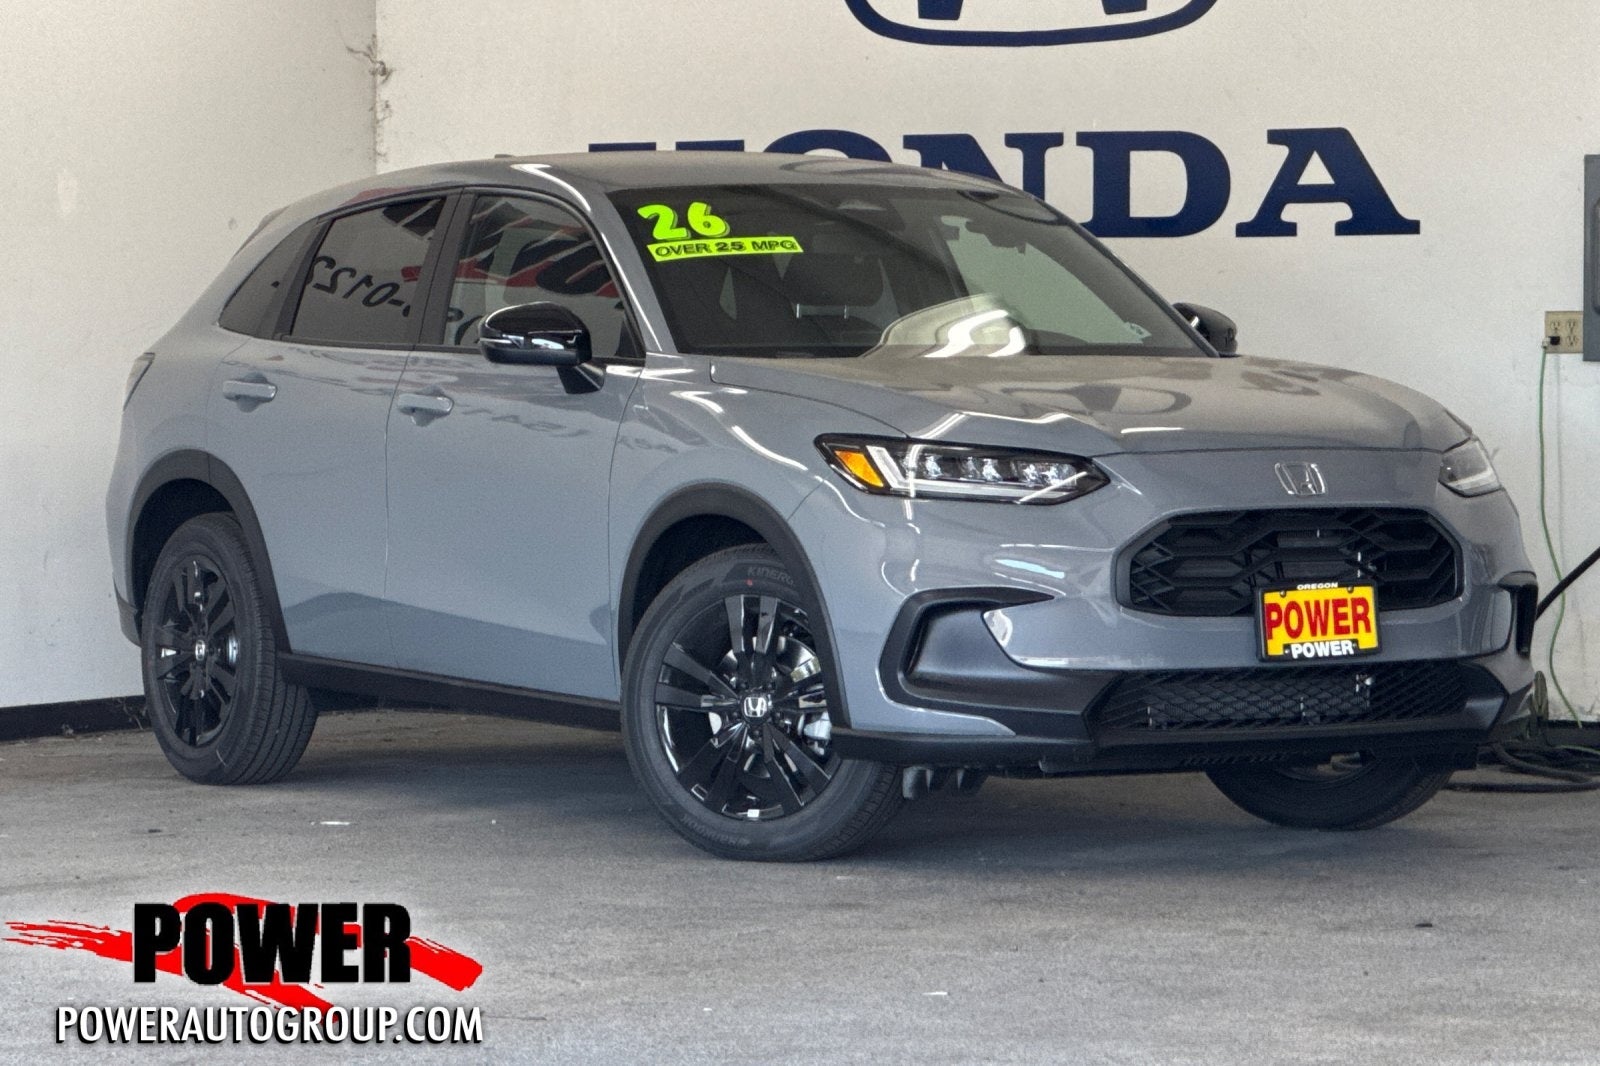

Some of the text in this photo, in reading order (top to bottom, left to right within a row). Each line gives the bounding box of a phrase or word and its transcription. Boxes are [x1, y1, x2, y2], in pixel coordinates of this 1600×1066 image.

[588, 127, 1421, 237] NDA
[637, 201, 731, 241] 26
[655, 239, 798, 258] OVER 25 MPG
[1264, 596, 1372, 641] POWER
[1291, 641, 1354, 659] POWER
